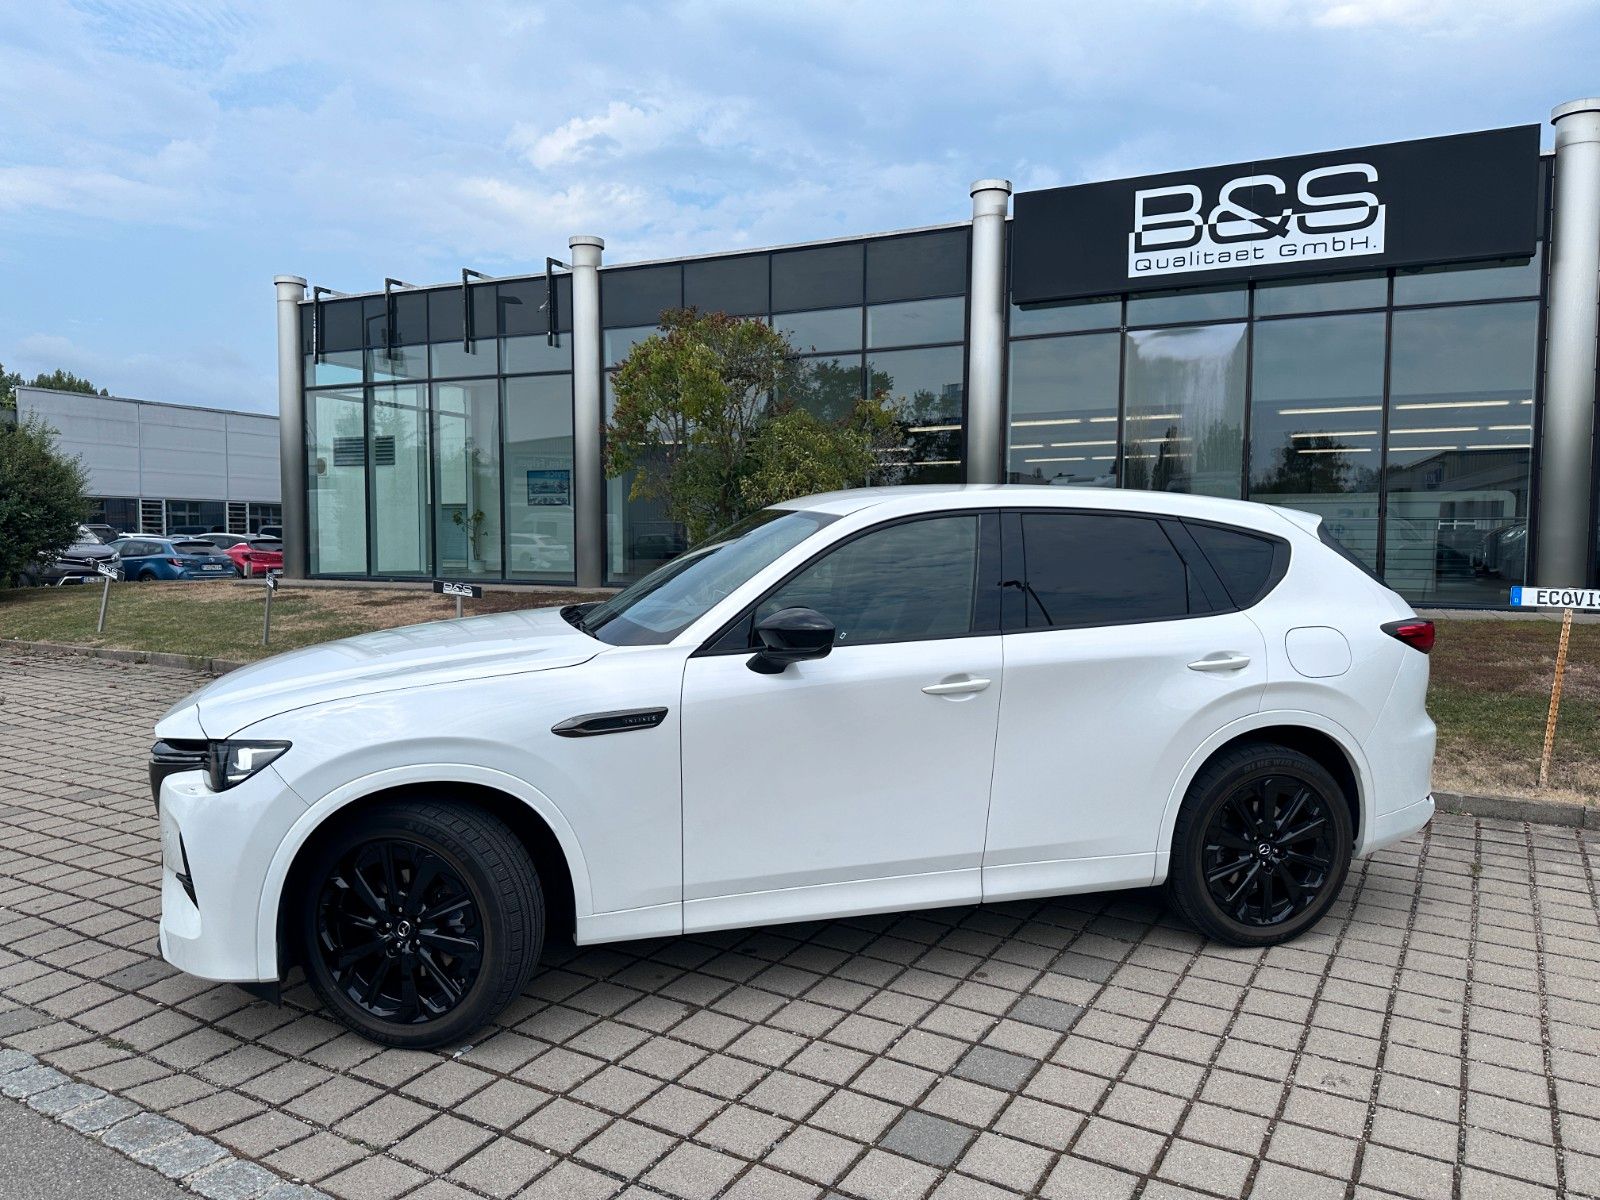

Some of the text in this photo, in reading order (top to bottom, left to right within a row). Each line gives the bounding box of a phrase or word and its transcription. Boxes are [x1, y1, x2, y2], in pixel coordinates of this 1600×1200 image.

[1134, 163, 1379, 253] B&S
[1135, 236, 1376, 271] Qualitaet GmbH.
[443, 582, 472, 595] B&S
[1537, 590, 1600, 606] ECOVI
